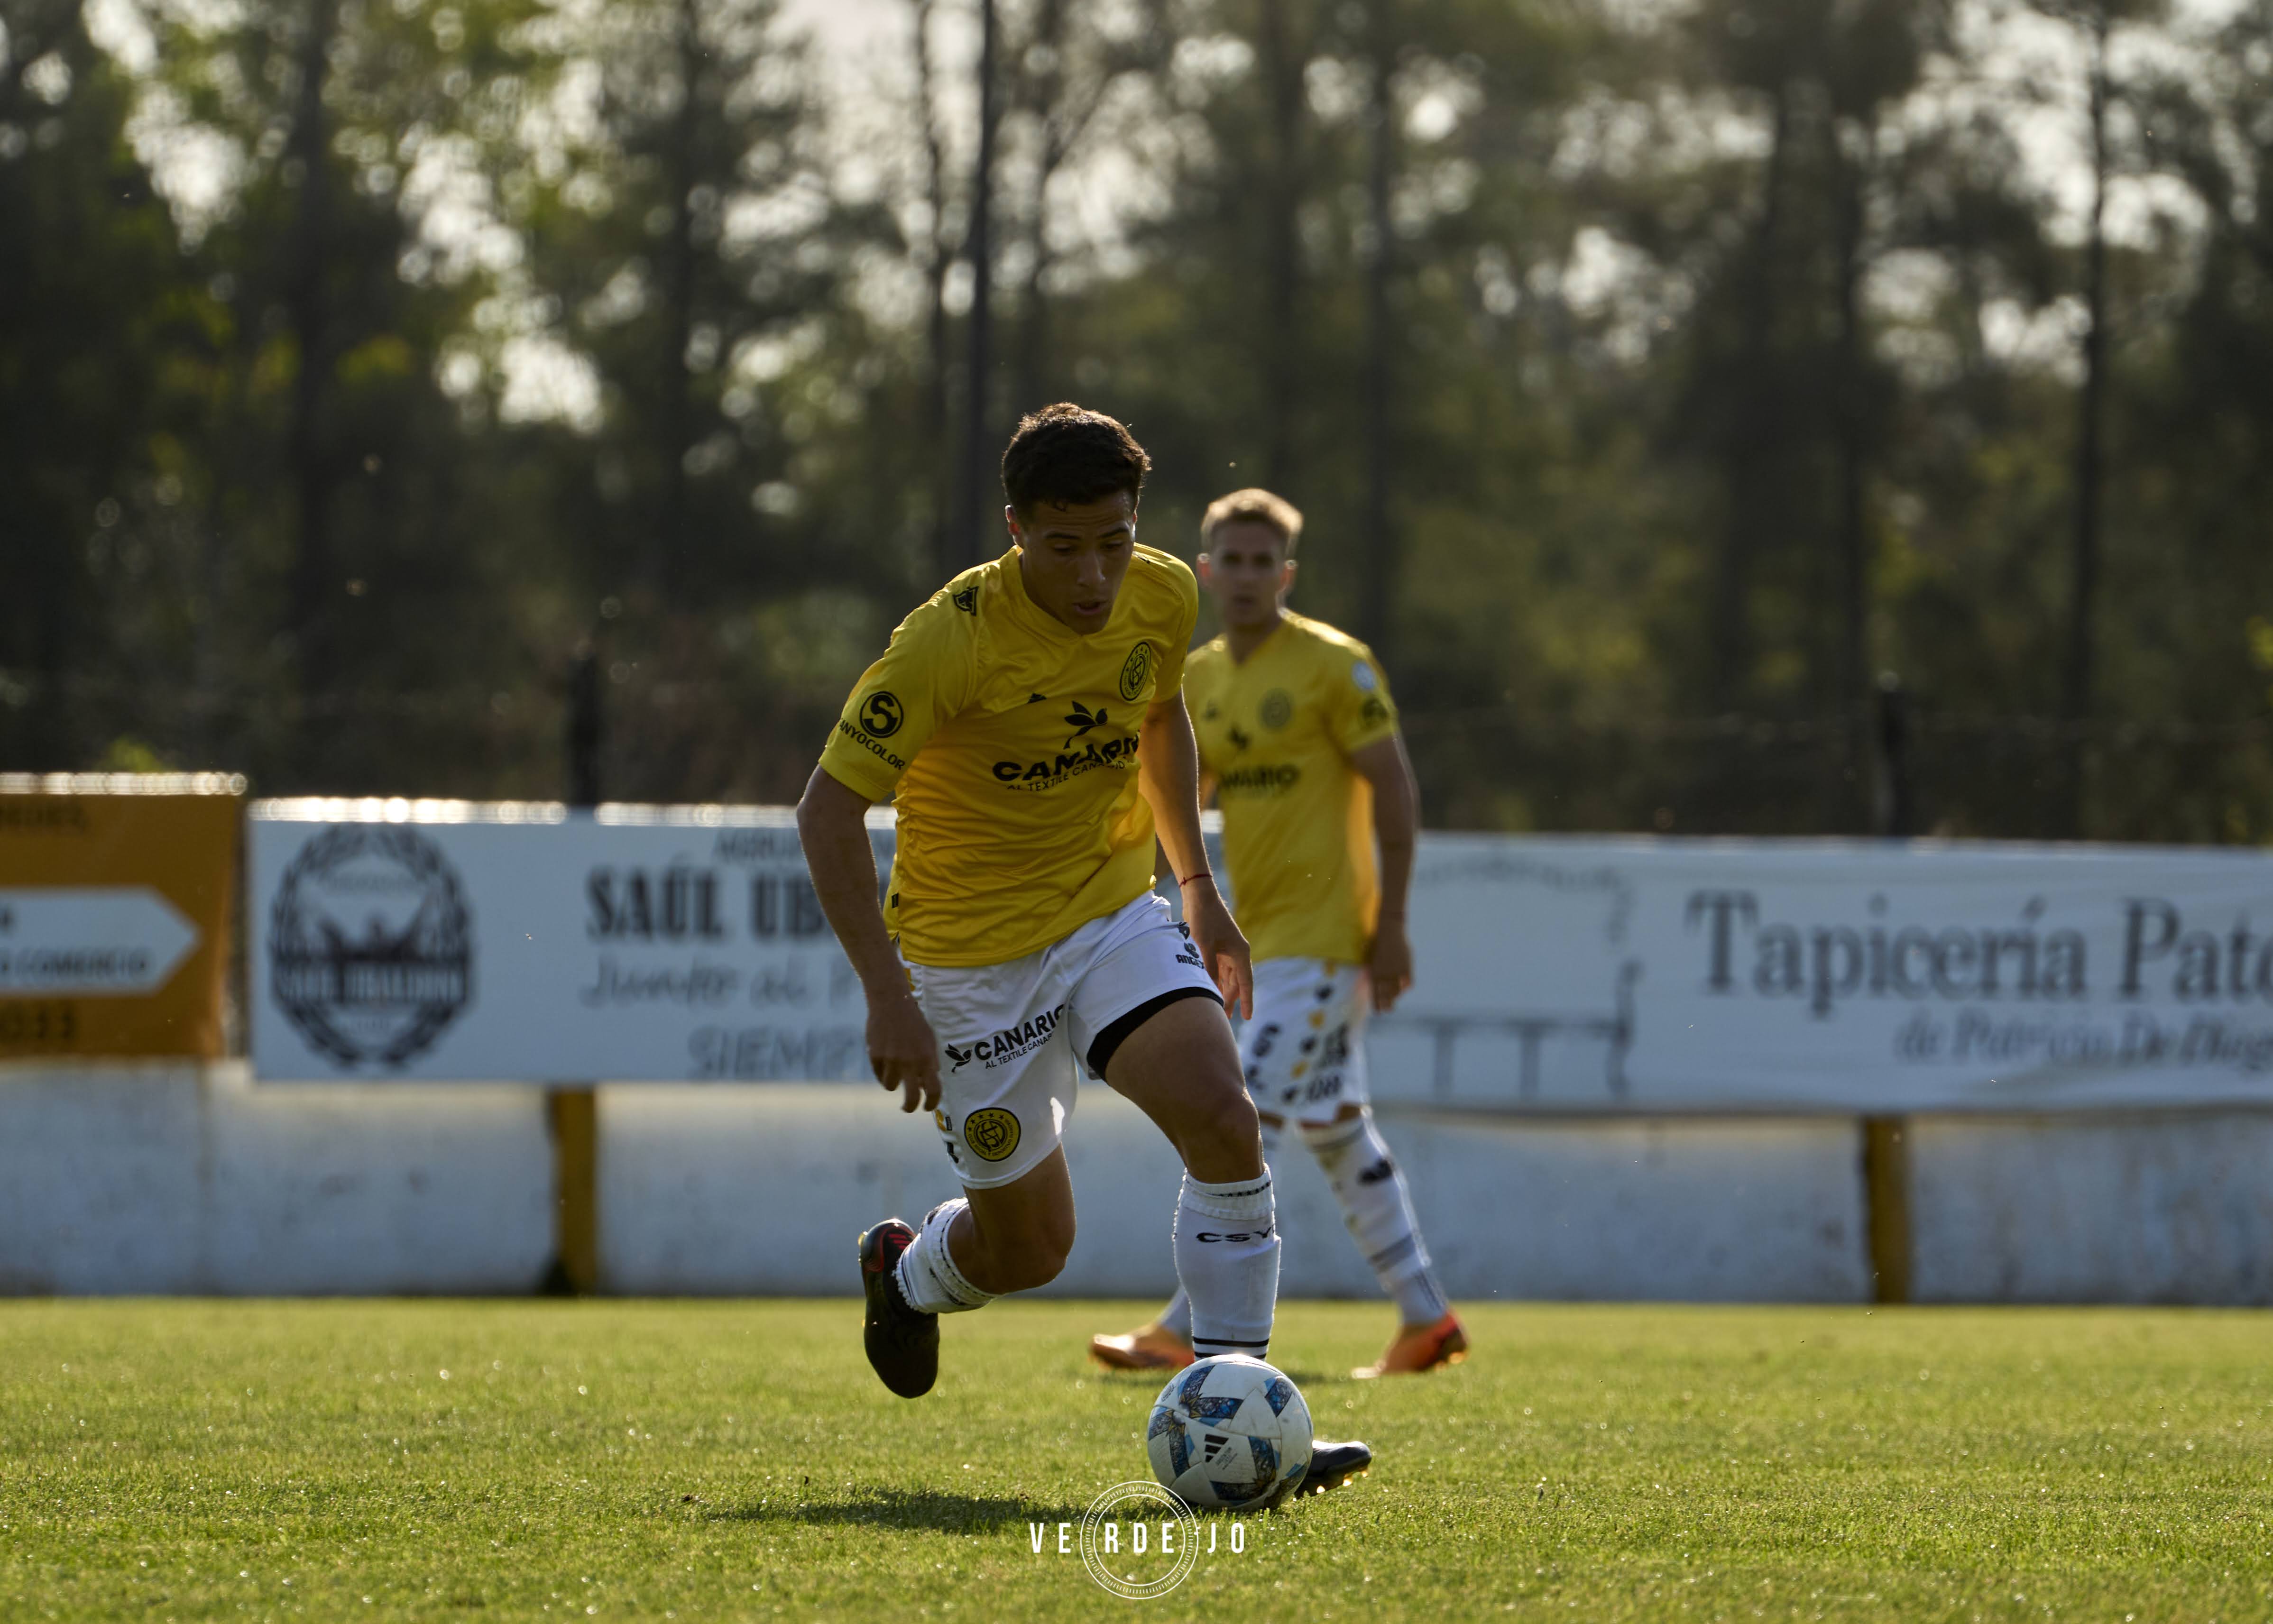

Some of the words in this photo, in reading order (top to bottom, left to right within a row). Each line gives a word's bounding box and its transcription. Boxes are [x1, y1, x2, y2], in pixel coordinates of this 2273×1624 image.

[840, 719, 905, 771] ANYOCOLOR
[1028, 771, 1069, 791] TEXTILE
[1684, 889, 2088, 1022] Tapicería
[985, 1060, 997, 1069] AL
[997, 1046, 1028, 1065] TEXTILE
[1196, 1223, 1275, 1243] CSY
